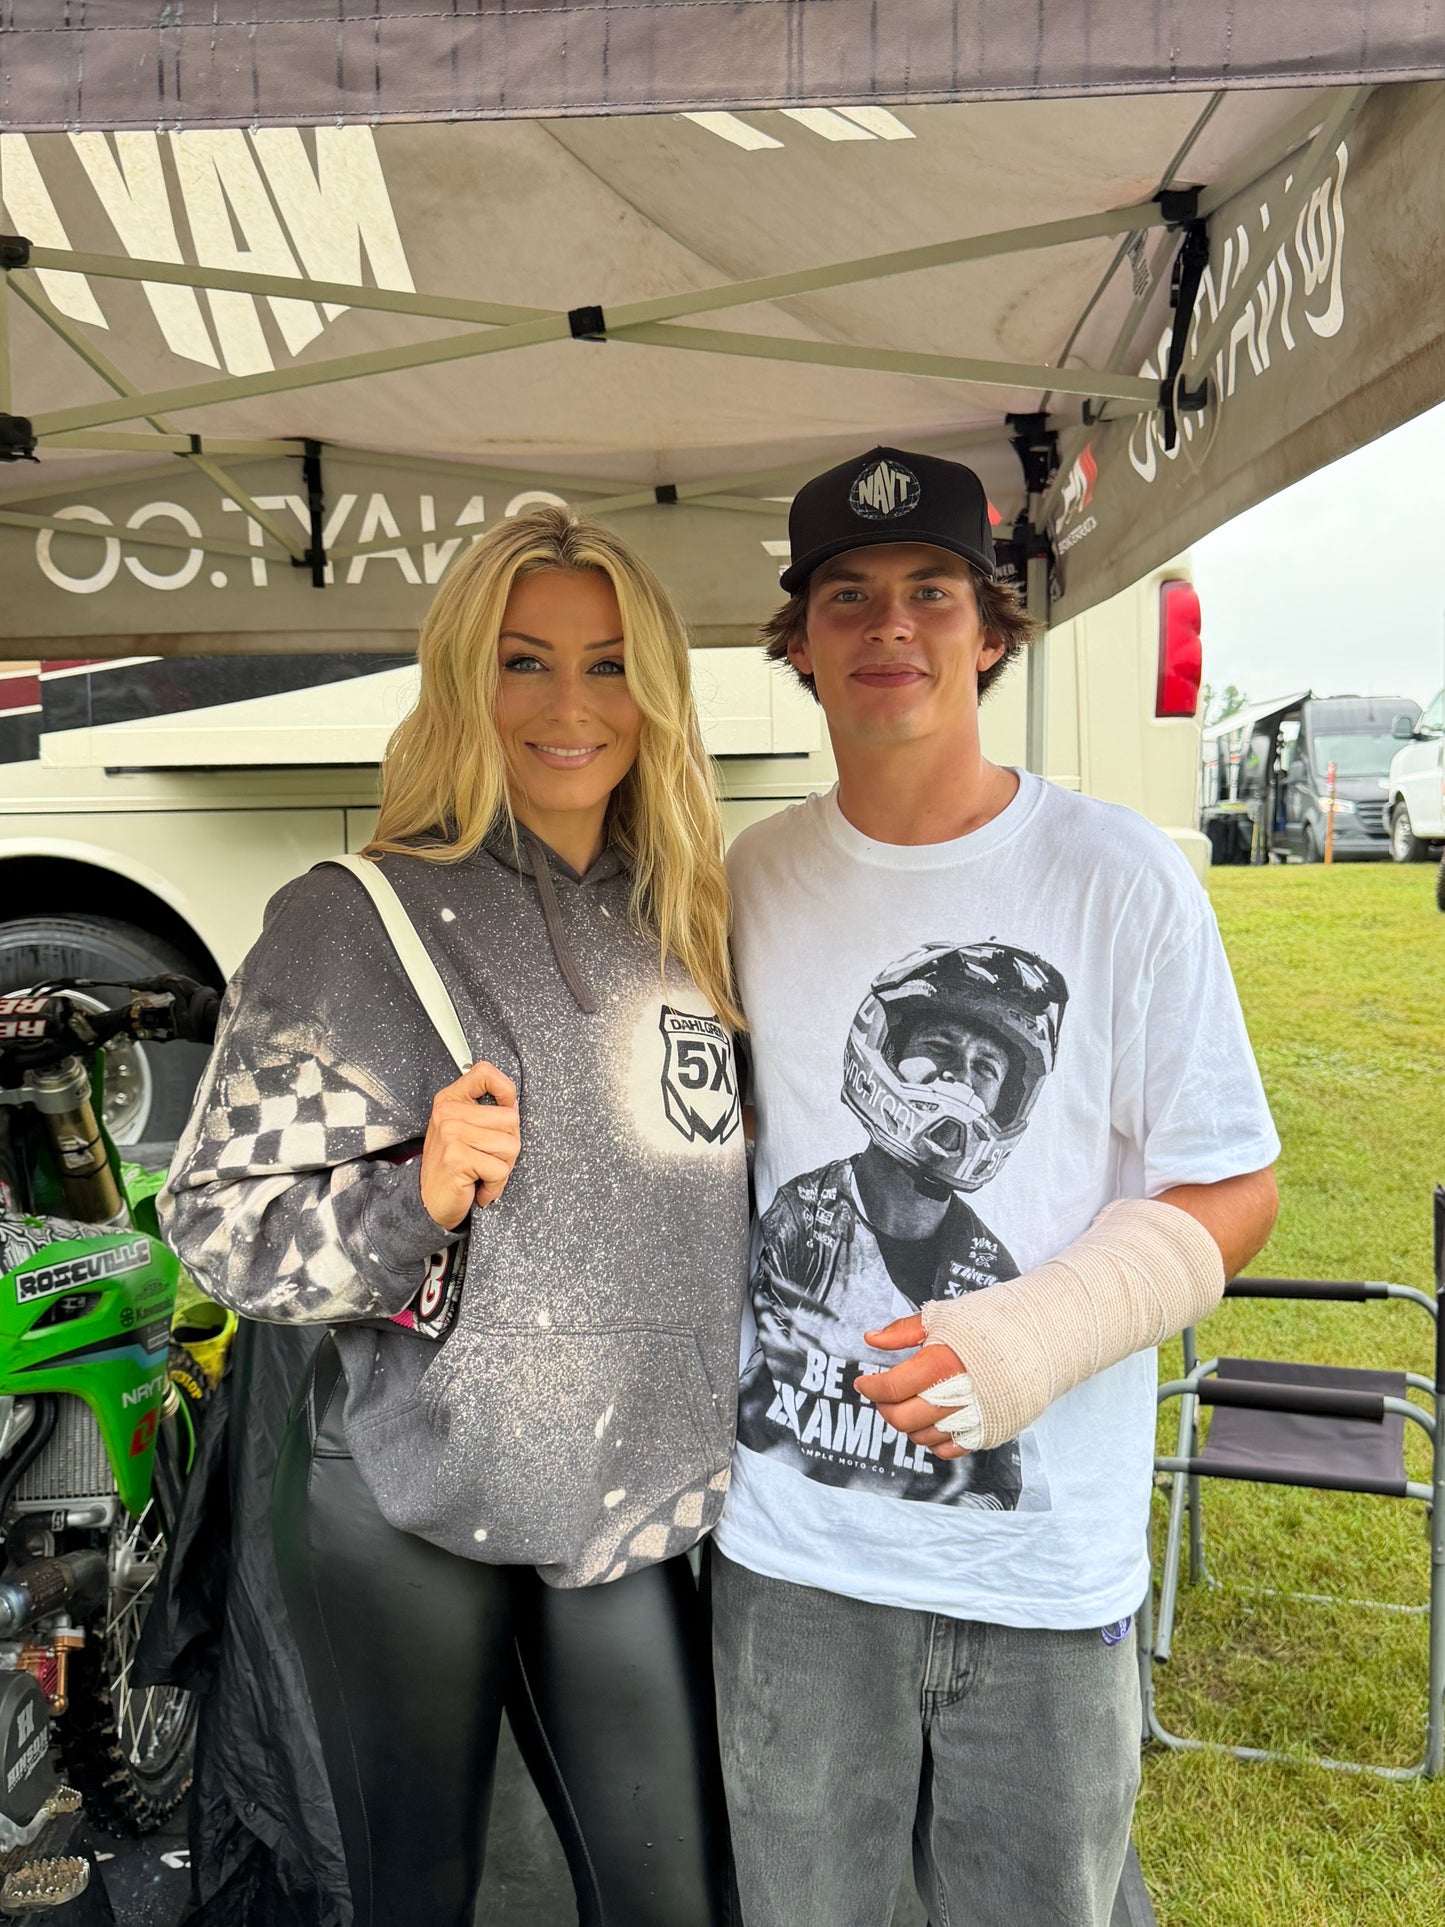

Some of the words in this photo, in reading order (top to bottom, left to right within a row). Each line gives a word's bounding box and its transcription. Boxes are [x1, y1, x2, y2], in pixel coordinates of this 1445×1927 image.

[858, 461, 910, 515] NAYT
[676, 1040, 733, 1096] 5X
[20, 1243, 149, 1298] ROSEVILLE
[122, 1375, 163, 1409] NAYT
[801, 1347, 846, 1399] BE
[838, 1457, 867, 1469] MOTO
[871, 1465, 890, 1473] CO
[7, 1726, 48, 1787] HINSON
